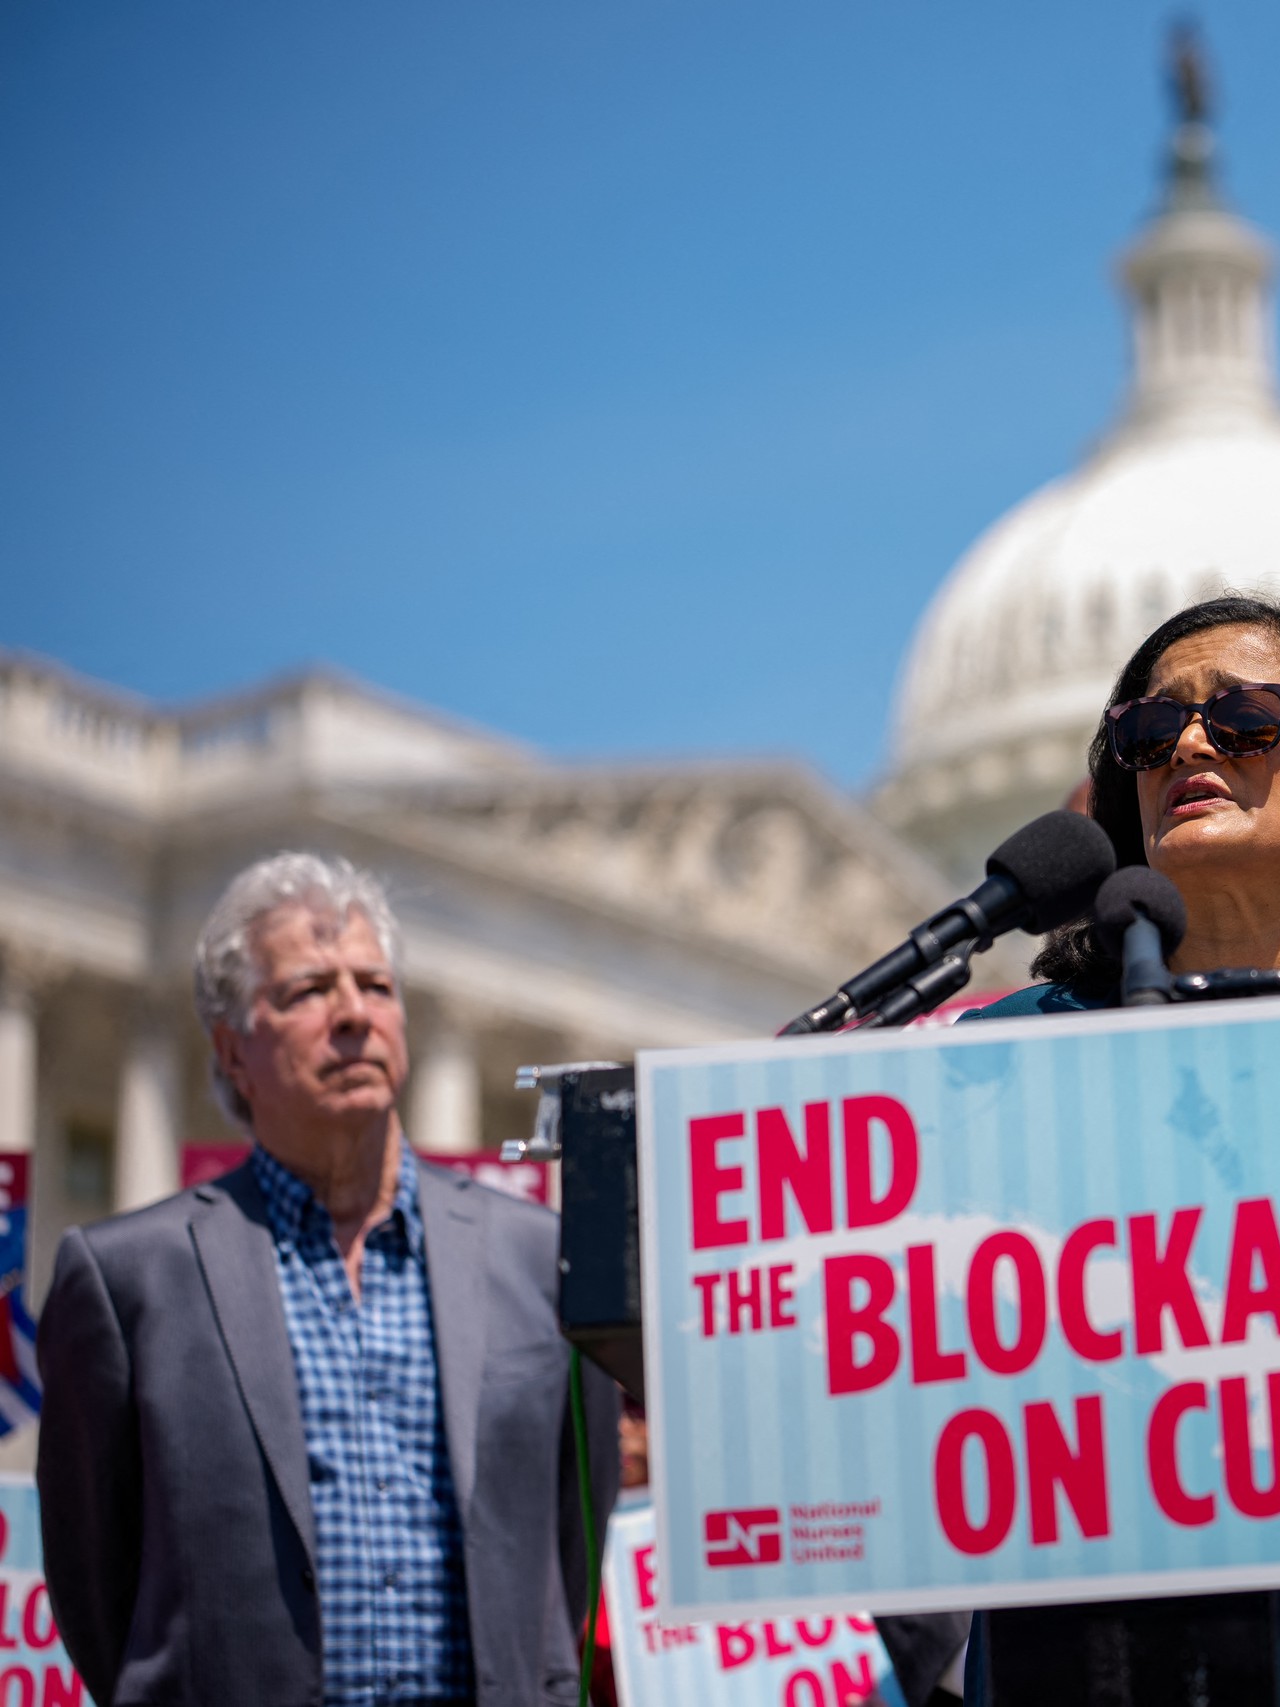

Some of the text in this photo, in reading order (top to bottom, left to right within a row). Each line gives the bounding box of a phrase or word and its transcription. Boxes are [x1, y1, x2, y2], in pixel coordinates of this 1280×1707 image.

[686, 1093, 921, 1252] END
[691, 1262, 798, 1339] THE
[933, 1393, 1112, 1557] ON
